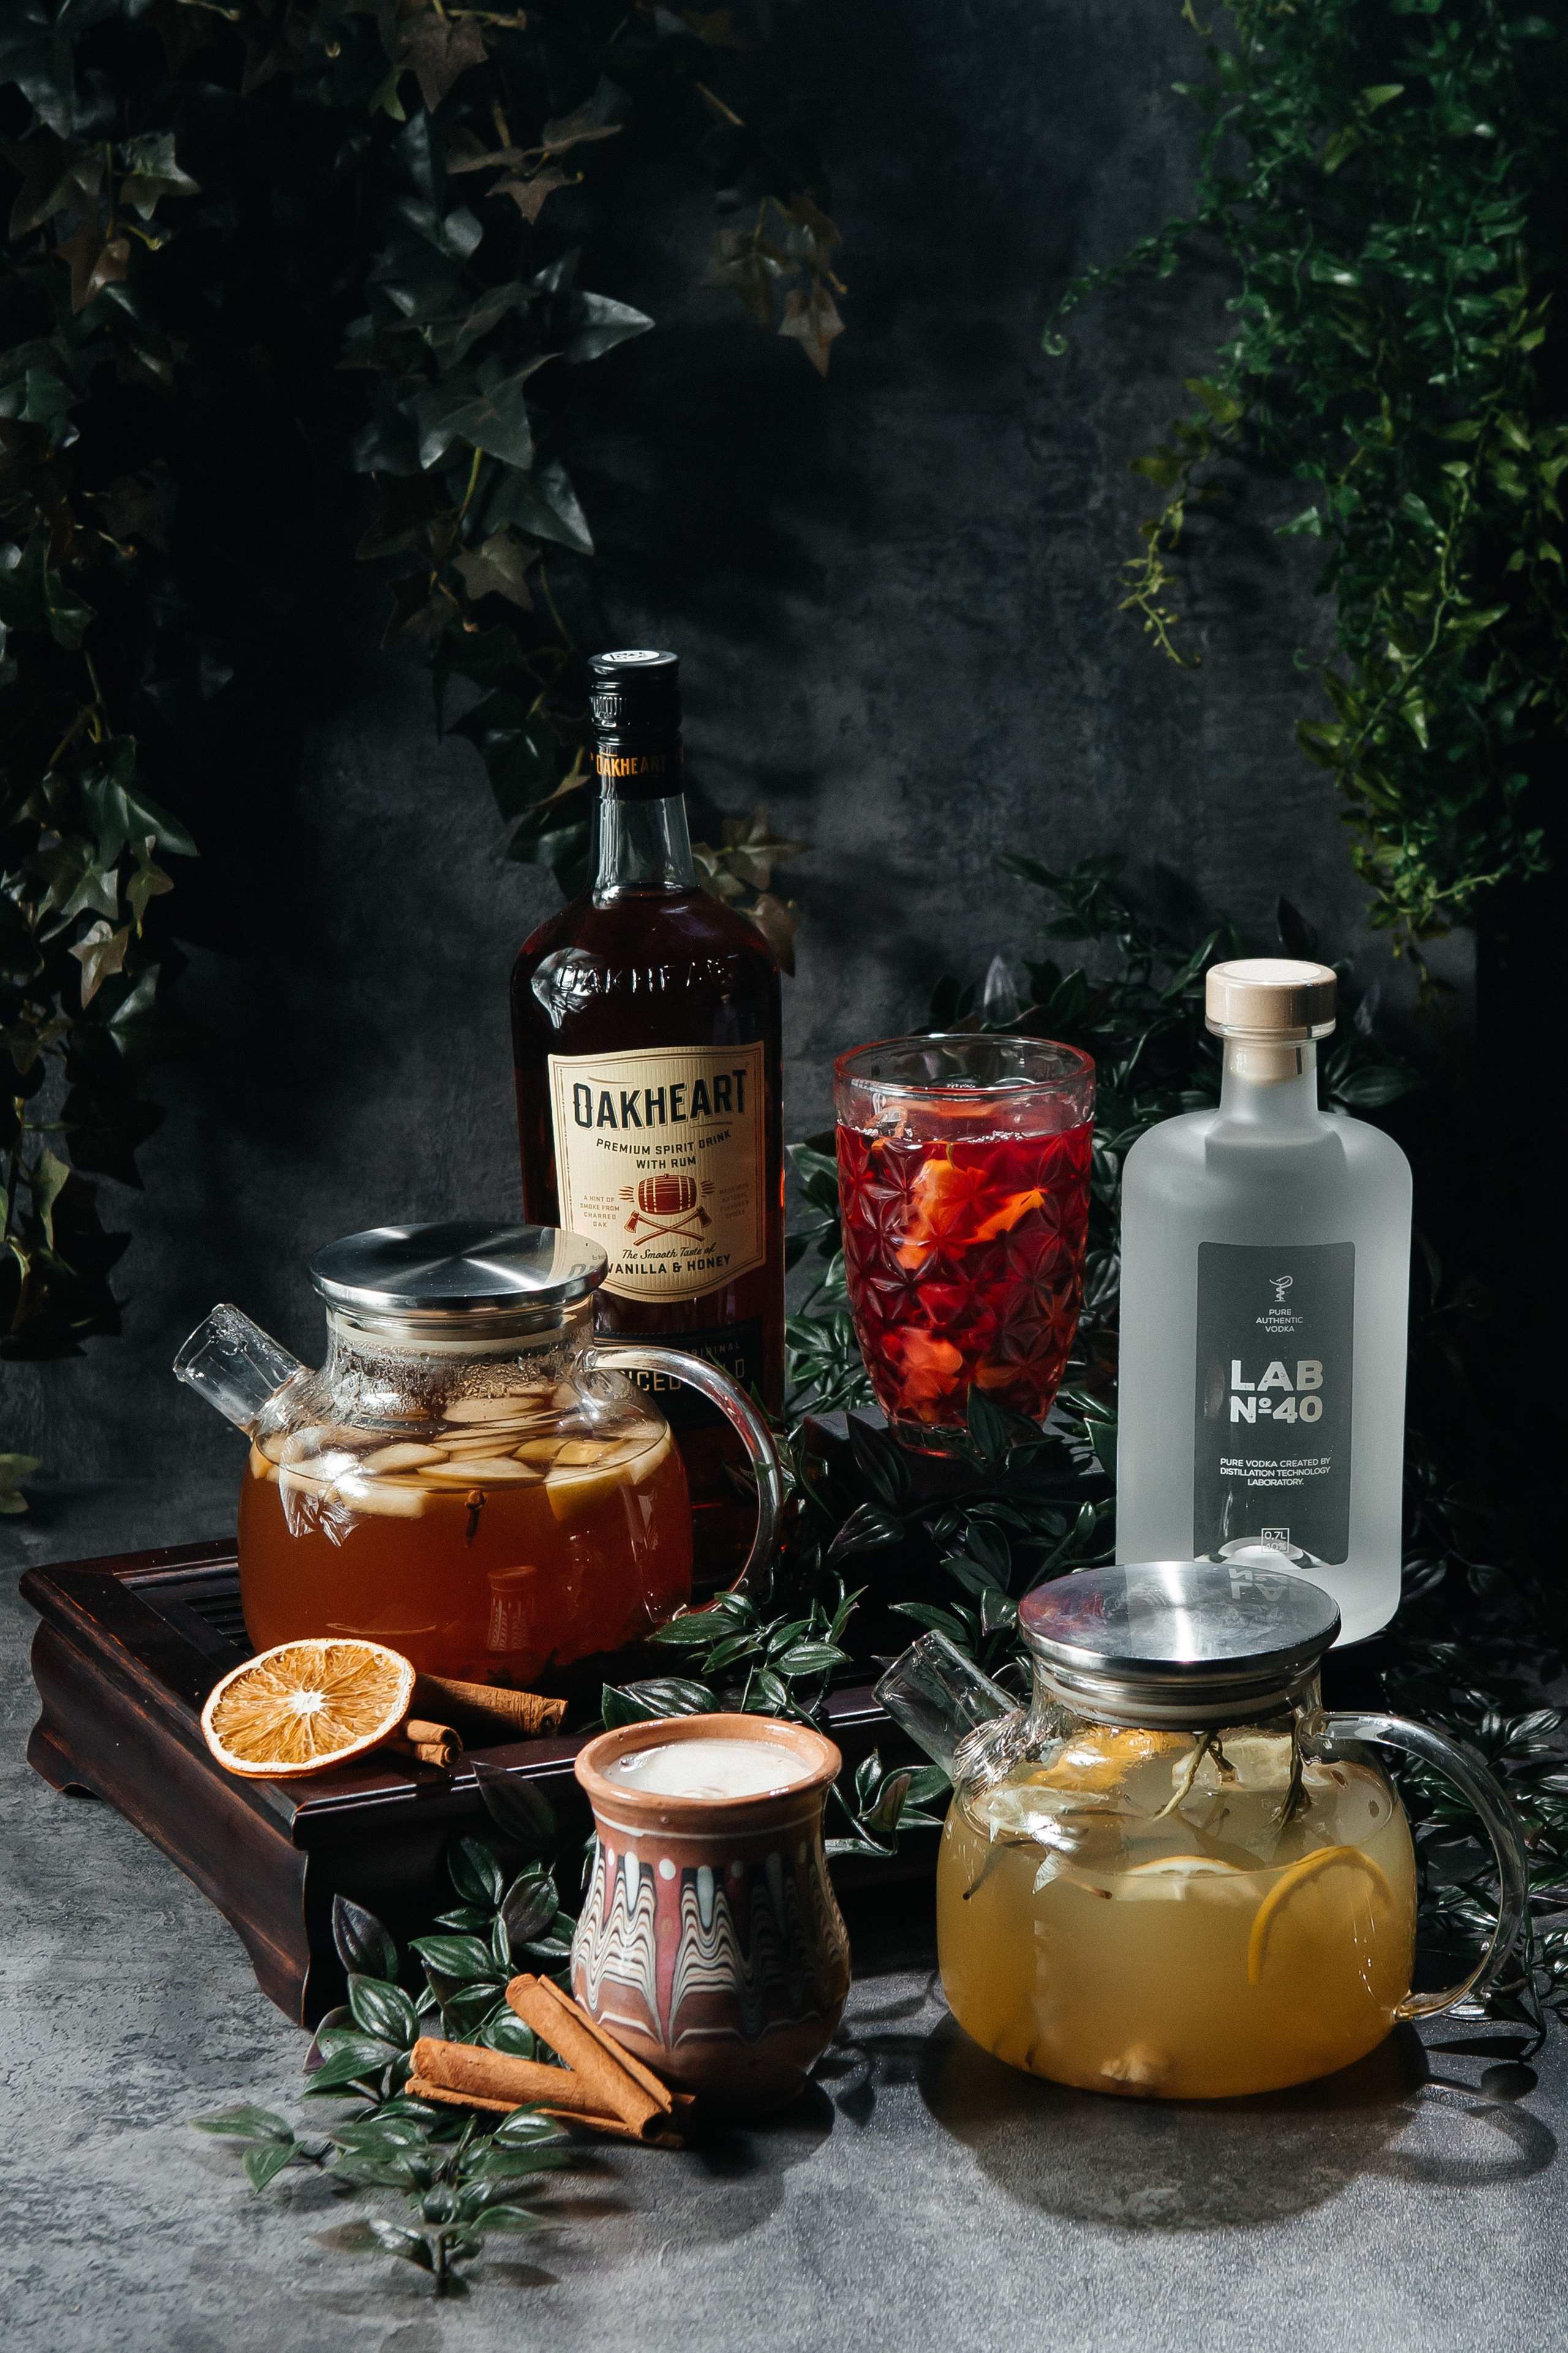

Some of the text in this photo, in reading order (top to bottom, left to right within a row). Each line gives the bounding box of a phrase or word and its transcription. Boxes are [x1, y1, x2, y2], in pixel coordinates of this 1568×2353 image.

[573, 1069, 747, 1130] OAKHEART
[597, 1130, 731, 1155] PREMIUM SPIRIT DRINK
[636, 1155, 696, 1169] WITH RUM
[622, 1241, 717, 1260] The Smooth Taste of
[608, 1262, 667, 1274] VANILLA
[673, 1261, 682, 1273] &
[687, 1253, 731, 1271] HONEY
[1231, 1359, 1324, 1391] LAB
[1220, 1457, 1243, 1467] PURE
[1280, 1458, 1319, 1467] CREATED
[1220, 1467, 1331, 1477] DISTILLATION TECHNOLOGY
